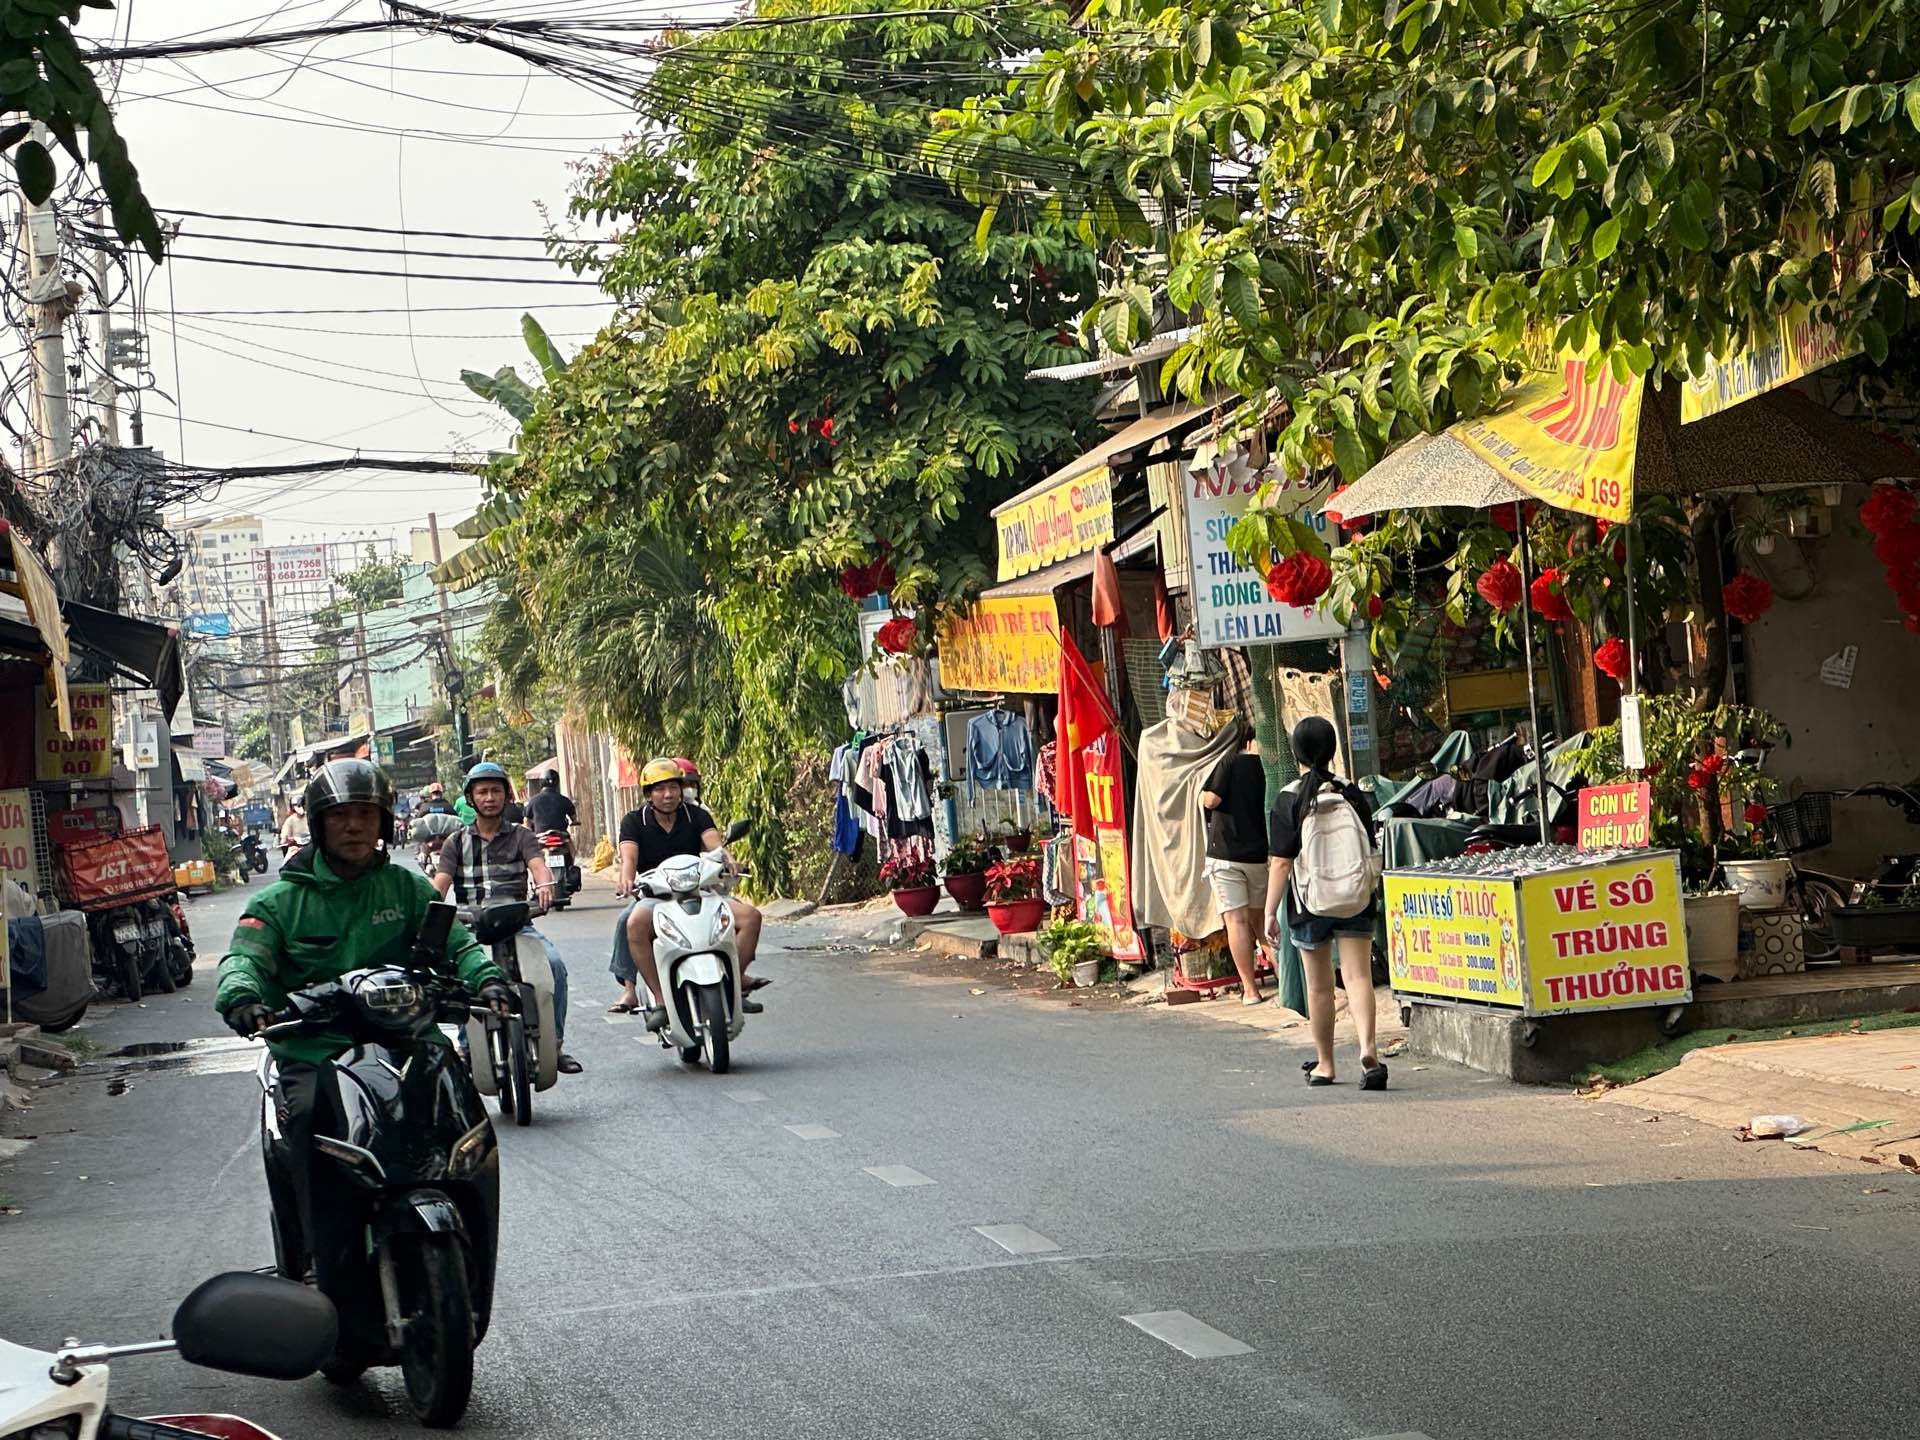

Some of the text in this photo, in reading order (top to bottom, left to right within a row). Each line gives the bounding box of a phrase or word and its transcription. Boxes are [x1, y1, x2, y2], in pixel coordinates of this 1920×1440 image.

[1591, 477, 1621, 508] 169
[1212, 578, 1261, 608] ĐÓNG
[1214, 611, 1282, 642] LÊN LAI
[1590, 790, 1639, 816] CÒN VÉ
[1441, 884, 1453, 917] SỐ
[1456, 883, 1473, 916] TÀI
[1477, 884, 1499, 924] LỘC
[1555, 869, 1655, 912] VÉ SỐ
[1412, 924, 1432, 953] 2 VÉ
[1552, 921, 1667, 957] TRÚNG
[1545, 962, 1684, 1003] THƯỞNG
